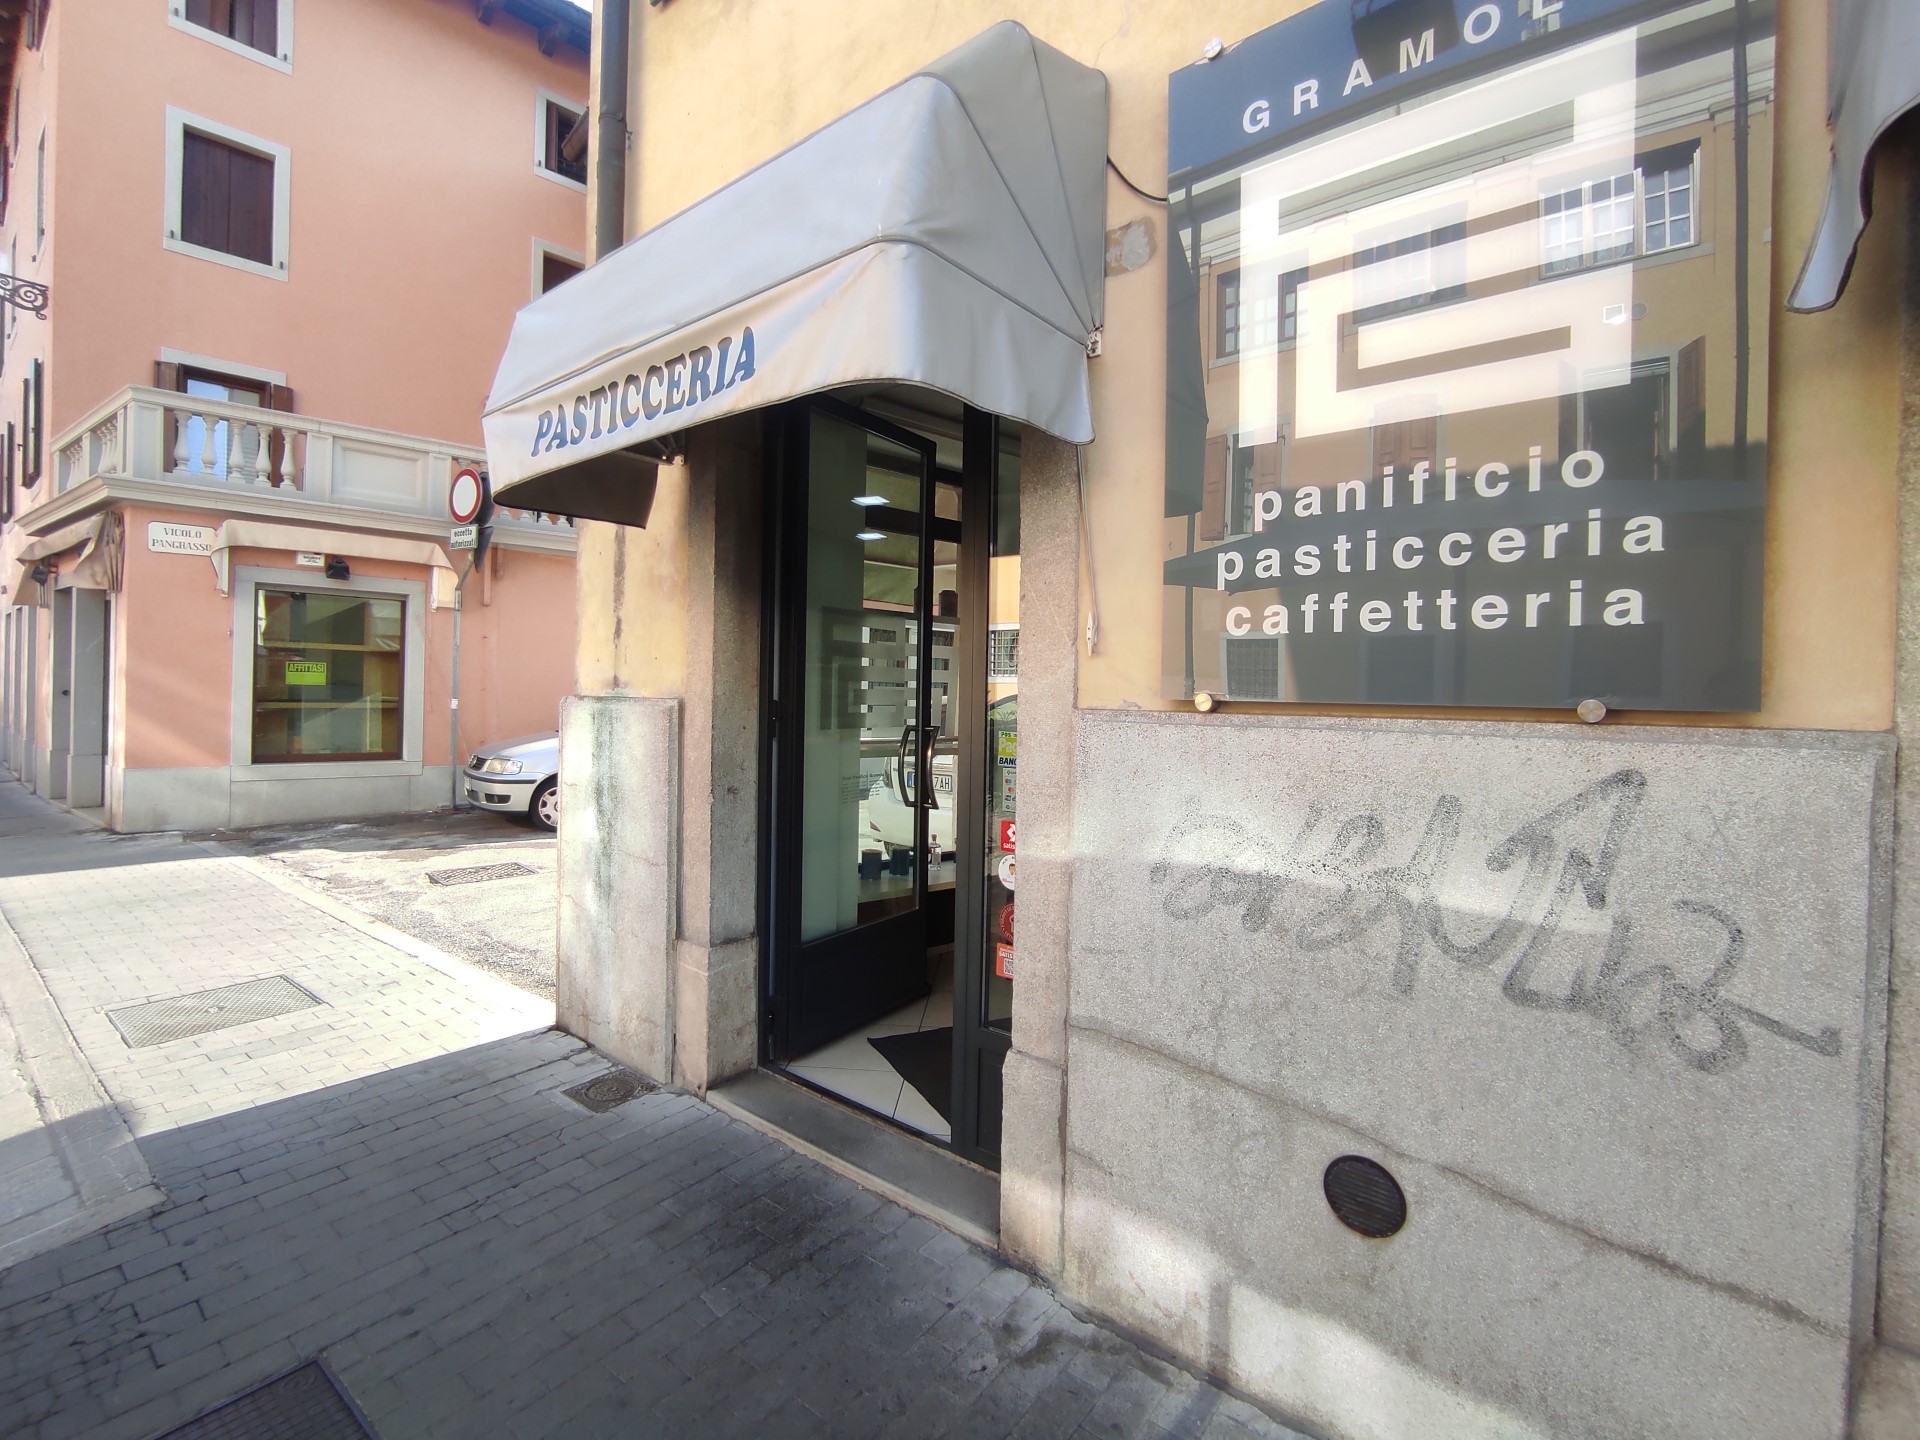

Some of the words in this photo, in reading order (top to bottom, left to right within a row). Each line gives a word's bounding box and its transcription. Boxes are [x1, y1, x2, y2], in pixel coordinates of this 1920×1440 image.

[531, 326, 757, 458] PASTICCERIA
[1254, 446, 1605, 532] panificio
[152, 539, 211, 551] PANGRASSO
[164, 527, 202, 538] VICOLO
[453, 528, 473, 538] eccetto
[1217, 508, 1665, 591] pasticceria
[1225, 580, 1645, 637] caffetteria
[288, 663, 325, 673] AFFITTASI
